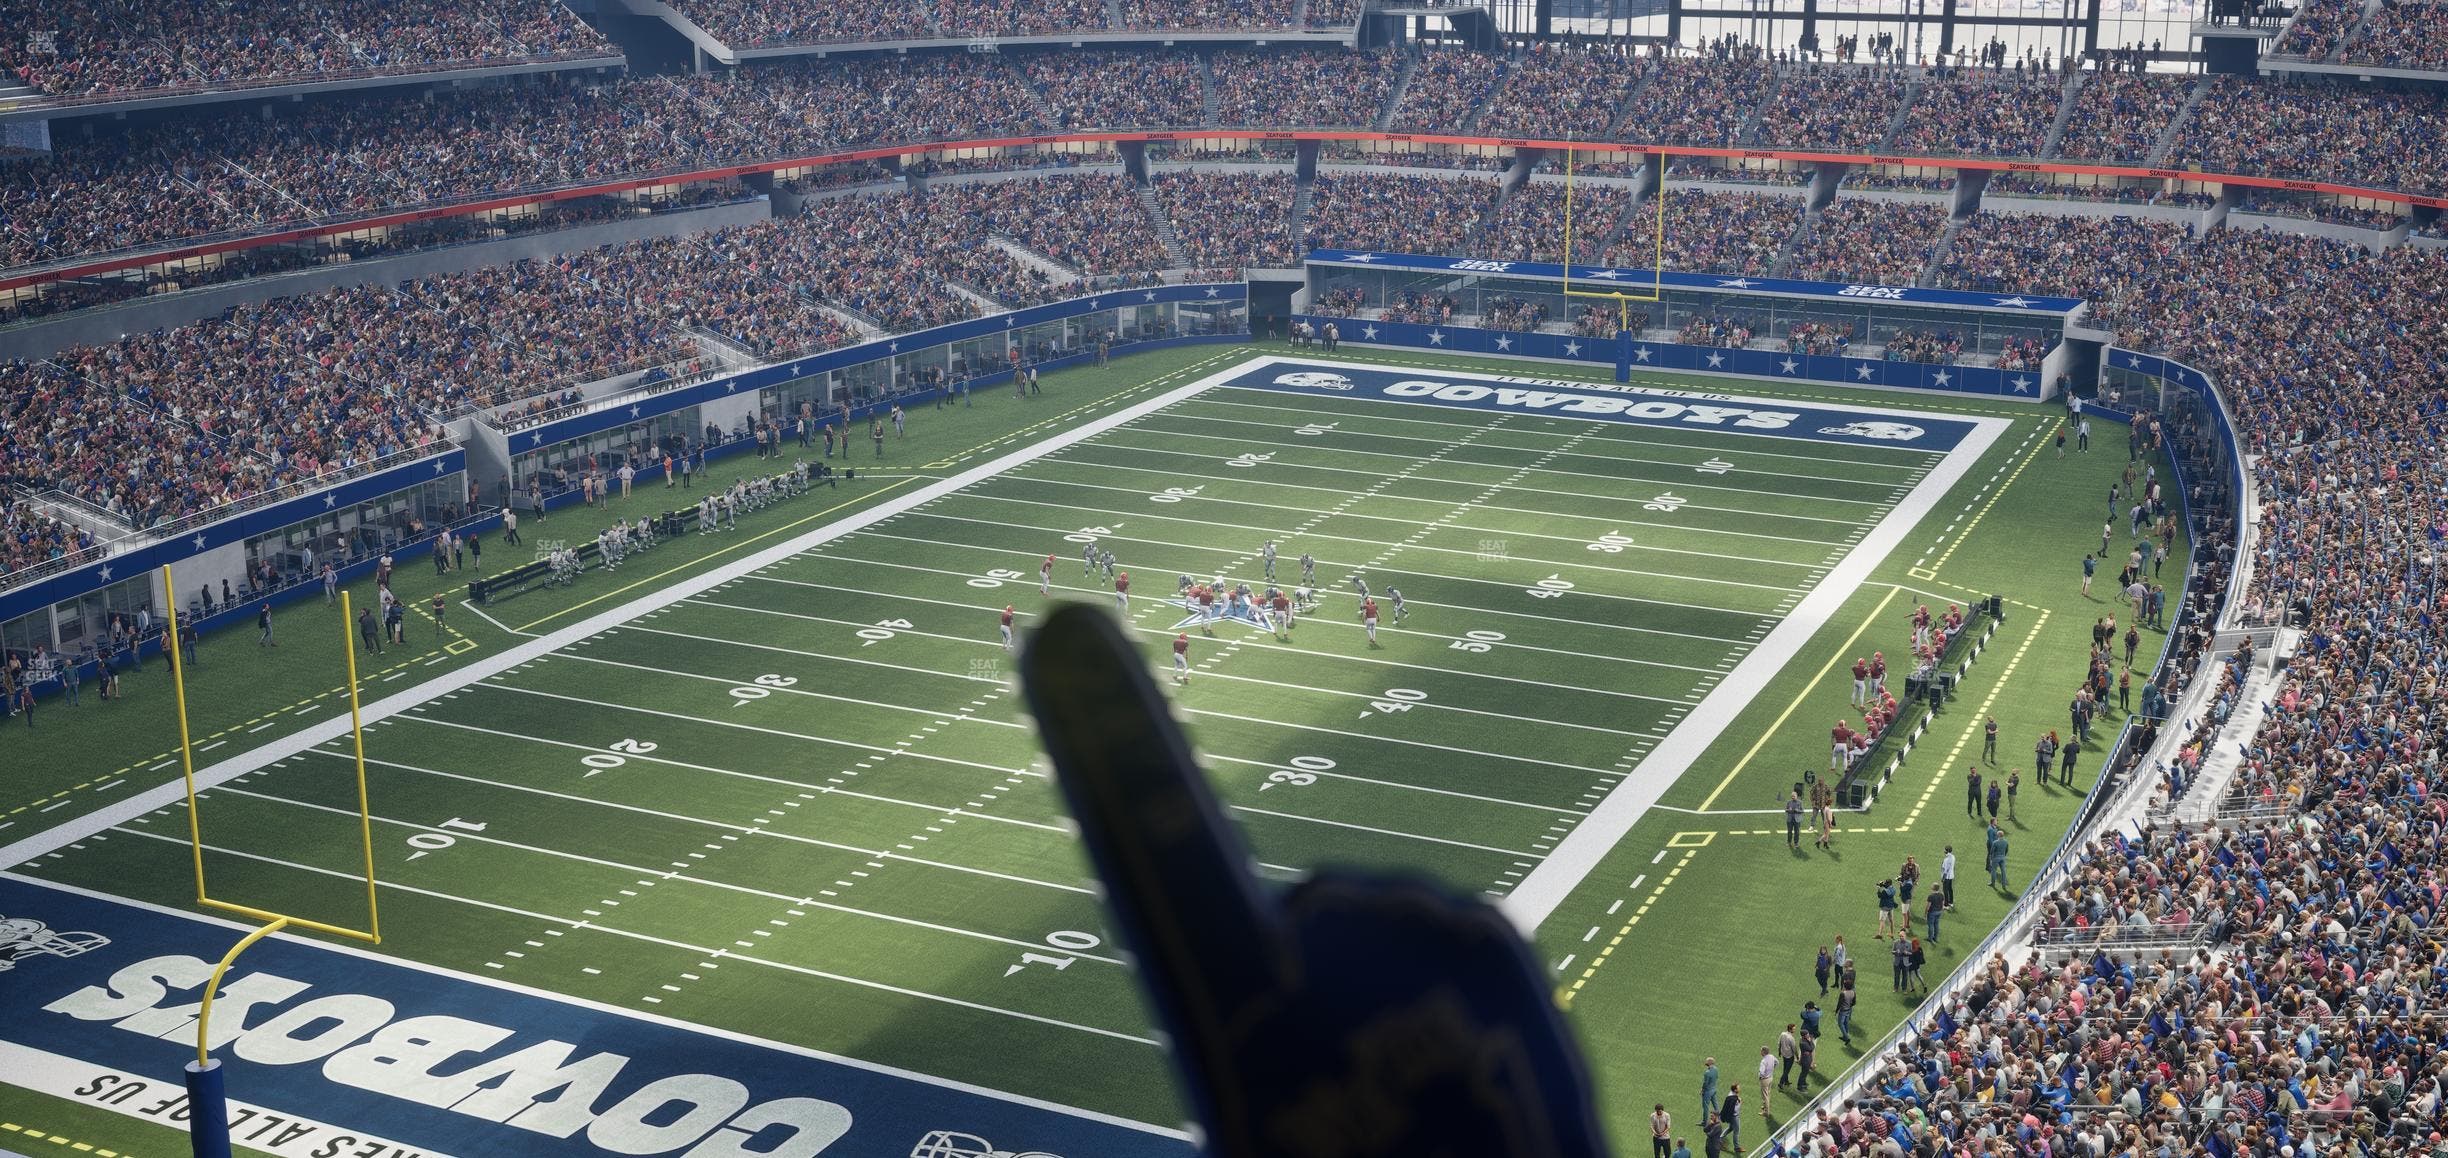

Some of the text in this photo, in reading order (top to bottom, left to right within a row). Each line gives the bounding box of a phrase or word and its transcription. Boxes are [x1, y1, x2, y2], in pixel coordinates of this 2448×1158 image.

[1620, 145, 1648, 153] SEATGEEK
[1873, 157, 1904, 165] SEATGEEK
[2008, 163, 2041, 171] SEATGEEK
[2149, 169, 2180, 178] SEATGEEK
[2284, 181, 2317, 190] SEATGEEK
[2408, 196, 2438, 206] SEATGEEK
[1449, 263, 1510, 272] GEEK
[1459, 260, 1516, 268] SEAT
[1837, 290, 1905, 299] GEEK
[1845, 285, 1908, 294] SEAT
[1528, 379, 1601, 389] TAKES
[1383, 380, 1800, 428] COWBOYS
[1294, 423, 1333, 435] 10
[1225, 453, 1271, 467] 20
[1694, 461, 1735, 475] 10
[1149, 487, 1198, 503] 30
[1642, 496, 1687, 512] 20
[1063, 526, 1113, 542] 40
[1586, 535, 1634, 553] 30
[966, 568, 1026, 588] 50
[1526, 579, 1575, 599] 40
[855, 618, 914, 640] 40
[1448, 630, 1507, 653] 50
[728, 673, 798, 699] 30
[1369, 688, 1428, 714] 40
[580, 737, 658, 769] 20
[1268, 756, 1337, 786] 30
[405, 817, 488, 850] 10
[1021, 930, 1101, 971] 10
[42, 954, 854, 1158] COWBOYS
[74, 1075, 147, 1105] US
[228, 1108, 318, 1148] ALL
